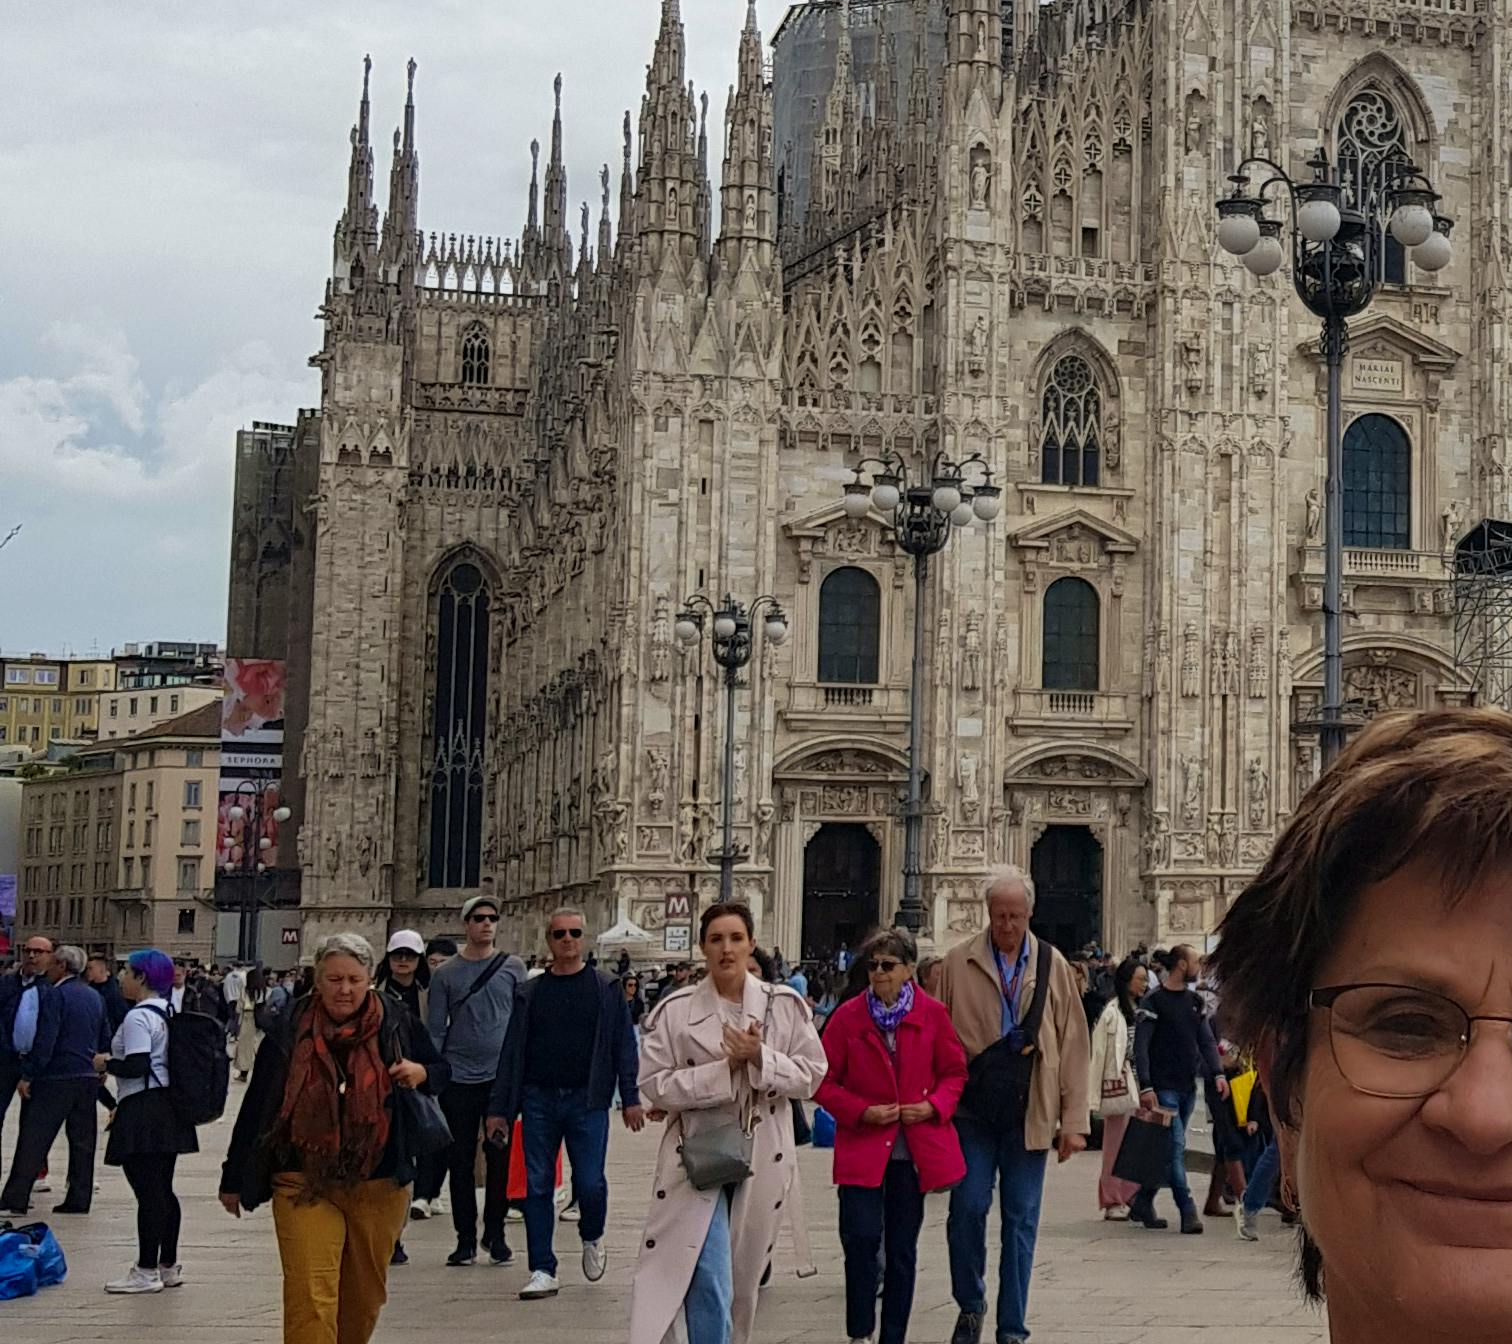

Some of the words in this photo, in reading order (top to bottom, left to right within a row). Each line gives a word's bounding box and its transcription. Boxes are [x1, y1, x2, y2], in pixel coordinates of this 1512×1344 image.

[1359, 364, 1394, 373] MARIAE
[1355, 375, 1399, 385] NASCENTI
[668, 896, 690, 914] M
[283, 931, 298, 942] M
